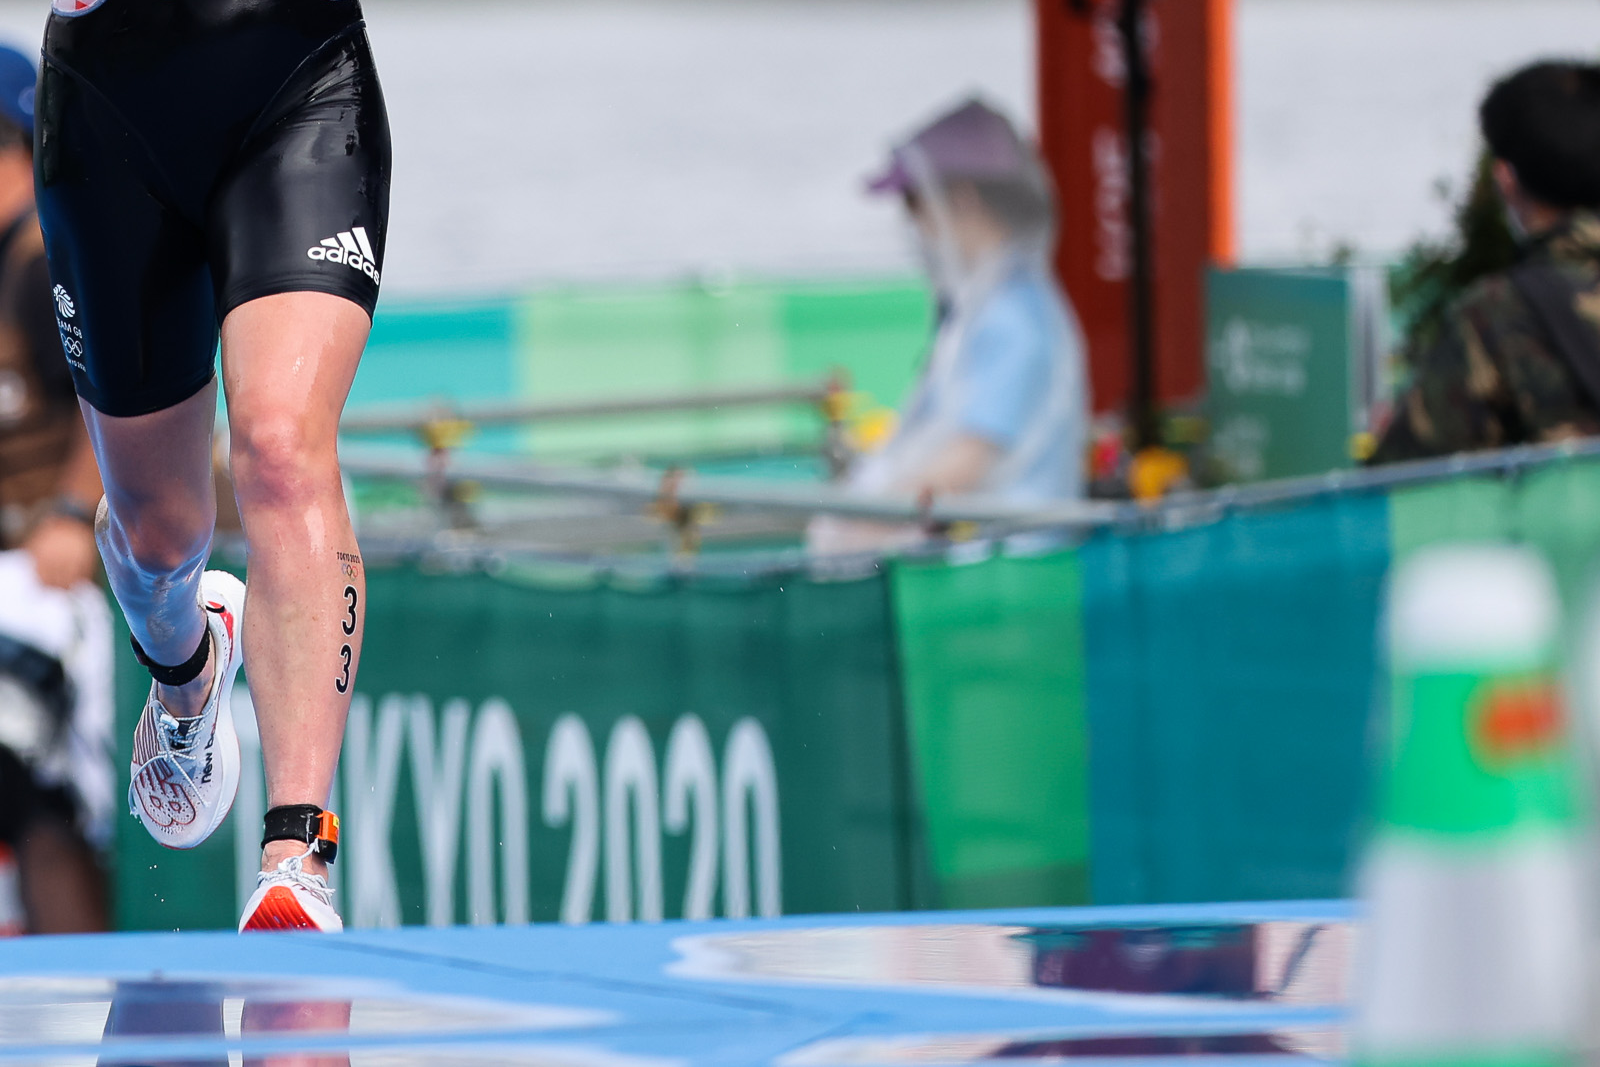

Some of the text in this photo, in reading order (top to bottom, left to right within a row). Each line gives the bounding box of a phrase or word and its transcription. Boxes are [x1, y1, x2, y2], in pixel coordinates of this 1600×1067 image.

[307, 246, 380, 286] adidas
[337, 551, 350, 562] TOKYO
[201, 752, 213, 784] new
[541, 712, 782, 924] 2020
